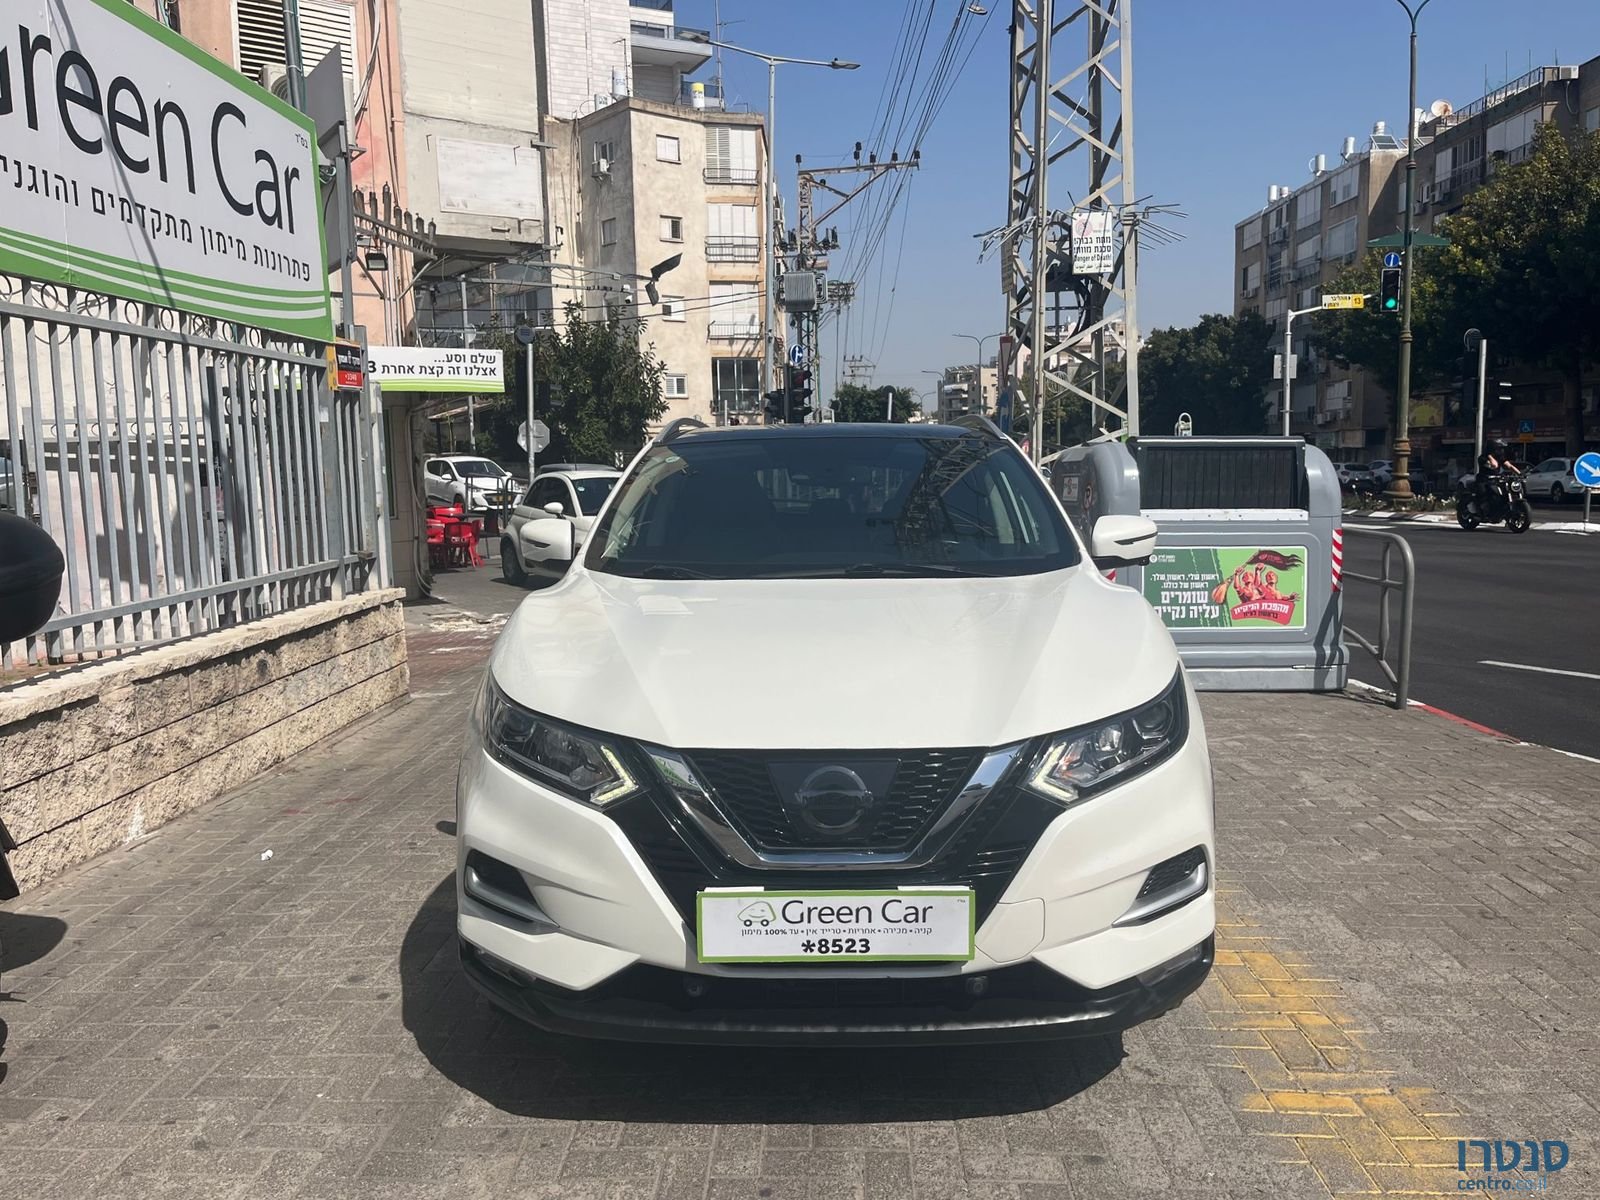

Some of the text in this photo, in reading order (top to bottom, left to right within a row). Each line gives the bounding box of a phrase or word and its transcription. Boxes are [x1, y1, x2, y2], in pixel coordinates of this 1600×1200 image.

[0, 24, 300, 234] reen Car
[91, 187, 193, 243] מתקדמים
[199, 225, 247, 260] מימון
[253, 245, 311, 282] פתרונות
[434, 353, 496, 364] שלם וסע...
[381, 365, 497, 378] אצלנו זה קצת אחרת
[1160, 591, 1208, 604] שומרים
[1190, 604, 1219, 619] עליה
[1261, 602, 1290, 614] מהפכת
[781, 899, 933, 924] Green Car
[741, 928, 762, 936] מימון
[806, 928, 818, 936] אין
[914, 927, 933, 935] קניה
